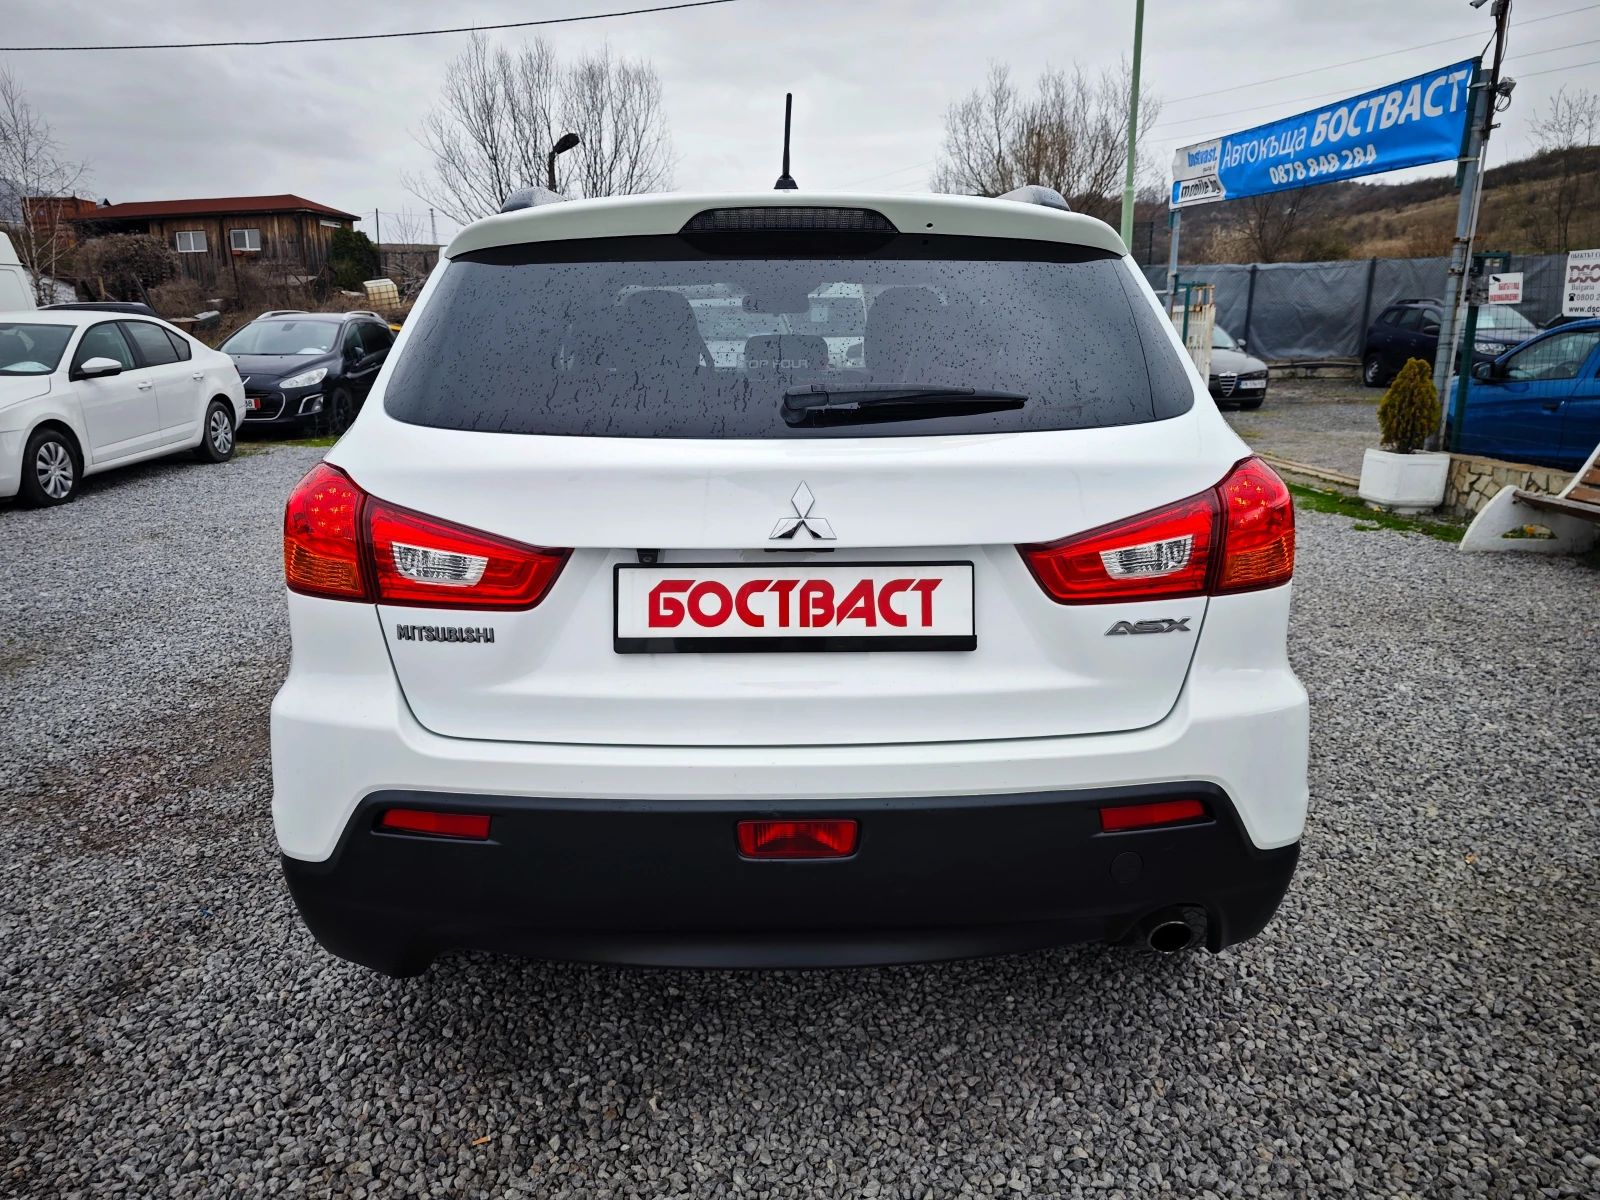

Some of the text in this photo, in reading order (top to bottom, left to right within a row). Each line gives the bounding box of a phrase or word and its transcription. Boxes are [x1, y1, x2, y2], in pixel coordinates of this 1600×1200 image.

[1310, 69, 1469, 148] БОСТВАСТ
[1269, 144, 1377, 185] 0878 848 284
[1181, 178, 1221, 199] mobilebg
[1571, 283, 1595, 292] Bulgaria
[648, 578, 944, 629] БОСТВАСТ
[396, 623, 495, 643] MITSUBISHI
[1103, 616, 1192, 636] ASX
